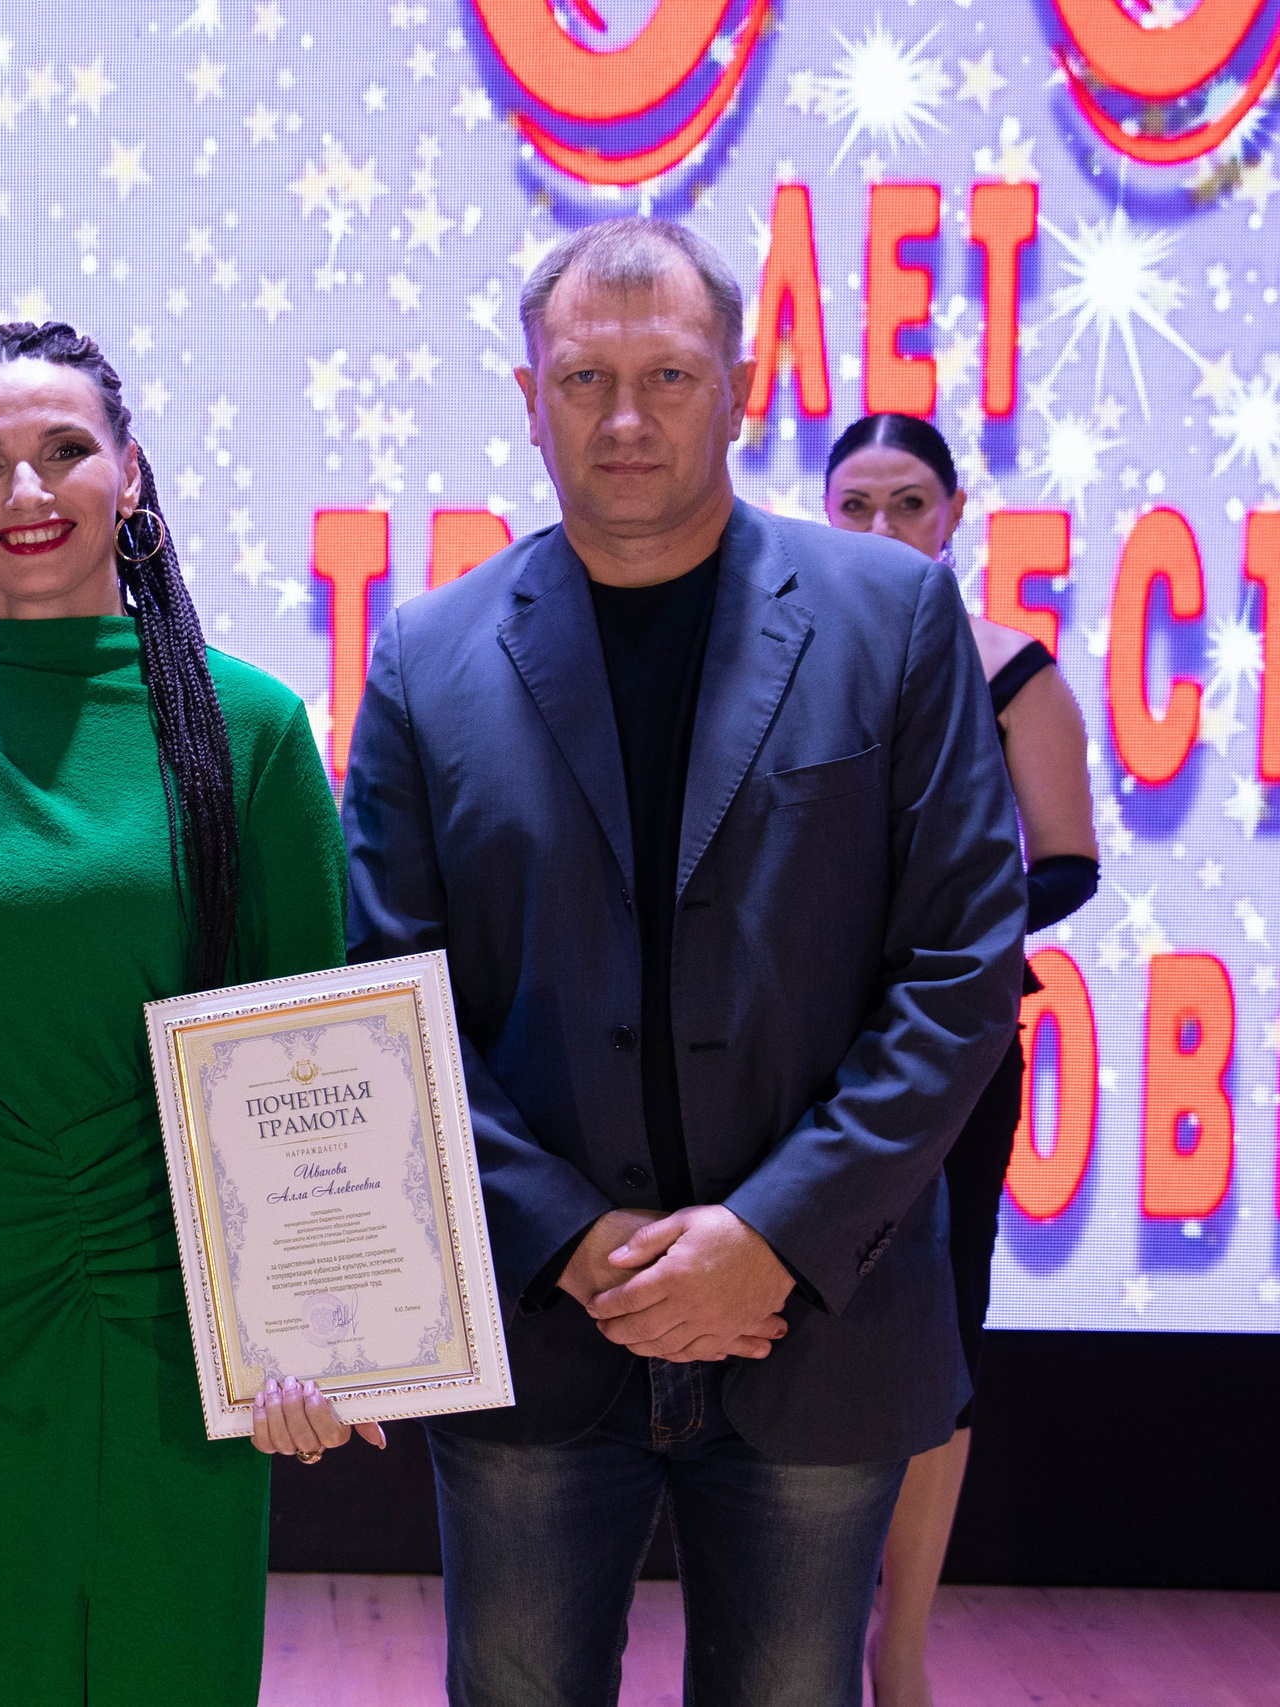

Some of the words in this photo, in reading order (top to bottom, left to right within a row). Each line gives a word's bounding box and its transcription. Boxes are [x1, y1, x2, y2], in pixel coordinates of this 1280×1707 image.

[746, 180, 1039, 419] ЛЕТ
[246, 1081, 373, 1117] ПОЧЕТНАЯ
[258, 1106, 367, 1138] ГРАМОТА
[286, 1142, 348, 1158] НАГРАЖДАЕТСЯ
[294, 1162, 347, 1179] Иванова
[267, 1186, 307, 1204] Алла
[312, 1178, 380, 1197] Алексеевна
[271, 1269, 312, 1282] популяризацию
[314, 1265, 341, 1276] кубанской
[369, 1256, 404, 1267] эстетическое
[278, 1258, 315, 1270] существенный
[365, 1247, 396, 1258] сохранение
[272, 1281, 302, 1290] воспитание
[308, 1275, 343, 1287] образование
[344, 1271, 370, 1280] молодого
[294, 1286, 328, 1297] многолетний
[329, 1281, 368, 1293] плодотворный
[370, 1280, 382, 1288] труд
